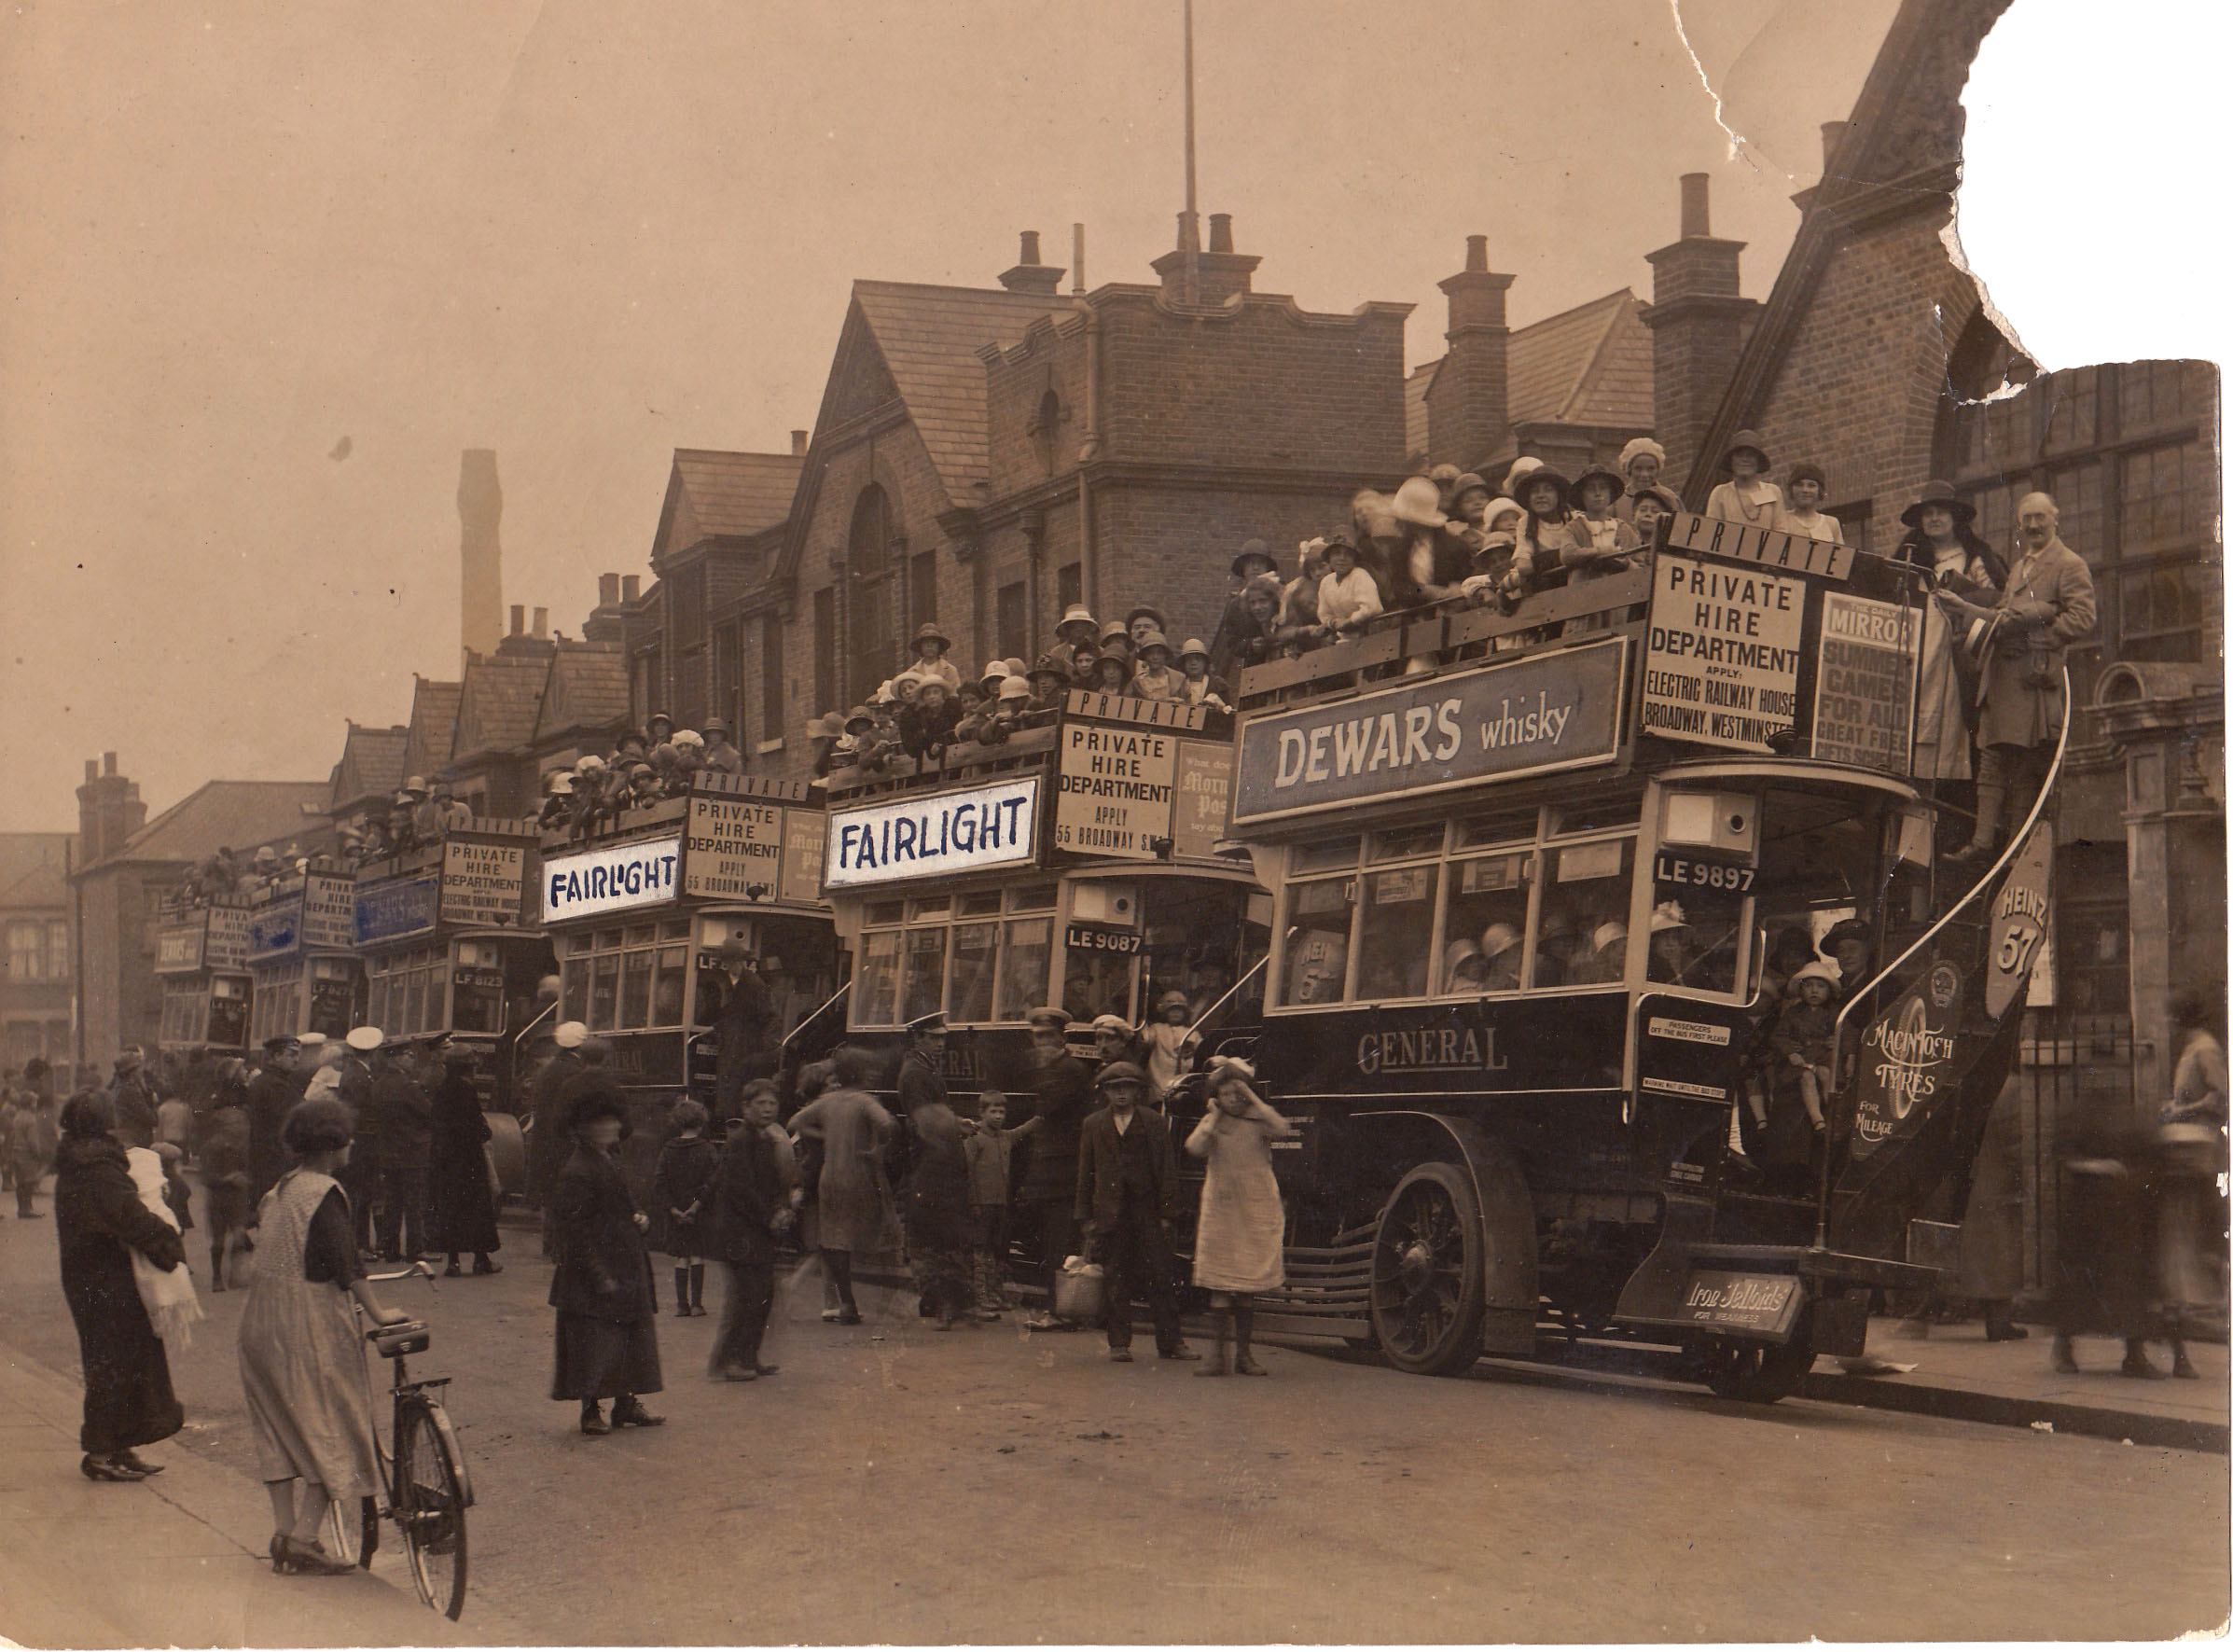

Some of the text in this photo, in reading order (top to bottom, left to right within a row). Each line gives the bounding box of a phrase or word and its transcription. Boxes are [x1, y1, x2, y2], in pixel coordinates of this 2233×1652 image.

[1686, 517, 1841, 576] PRIVATE
[1670, 565, 1792, 611] PRIVATE
[1695, 603, 1760, 636] HIRE
[1650, 627, 1798, 674] DEPARTMENT
[1646, 670, 1796, 716] ELECTRIC RAILWAY HOUSE
[1080, 692, 1196, 728] PRIVATE
[1819, 693, 1863, 724] FOR
[1073, 730, 1164, 758] PRIVATE
[1274, 690, 1572, 789] DEWAR'S whisky
[1091, 756, 1142, 777] HIRE
[704, 772, 799, 799] PRIVATE
[1061, 774, 1172, 803] DEPARTMENT
[699, 802, 774, 825] PRIVATE
[1095, 805, 1128, 826] APPLY
[714, 821, 756, 839] HIRE
[839, 796, 1028, 869] FAIRLIGHT
[1057, 825, 1071, 842] 55
[1078, 827, 1134, 851] BROADWAY
[452, 846, 517, 863] PRIVATE
[688, 837, 780, 859] DEPARTMENT
[445, 874, 522, 891] DEPARTMENT
[466, 862, 501, 875] HIRE
[550, 855, 676, 908] FAIRLIGHT
[687, 875, 699, 889] 55
[719, 861, 746, 877] APPLY
[1657, 857, 1755, 892] LE 9897
[2001, 886, 2048, 928] HEINZ
[1069, 930, 1142, 953] LE 9087
[1997, 924, 2038, 979] 57
[700, 955, 717, 969] LF
[1664, 1028, 1675, 1036] THE
[1688, 1032, 1706, 1040] FIRST
[1706, 1034, 1728, 1044] PLEASE
[1668, 1020, 1712, 1034] PASSENGERS
[1358, 1027, 1508, 1075] GENERAL
[1876, 1063, 1935, 1102] TYRES
[1859, 1101, 1879, 1116] FOR
[1856, 1113, 1893, 1143] MILEAGE
